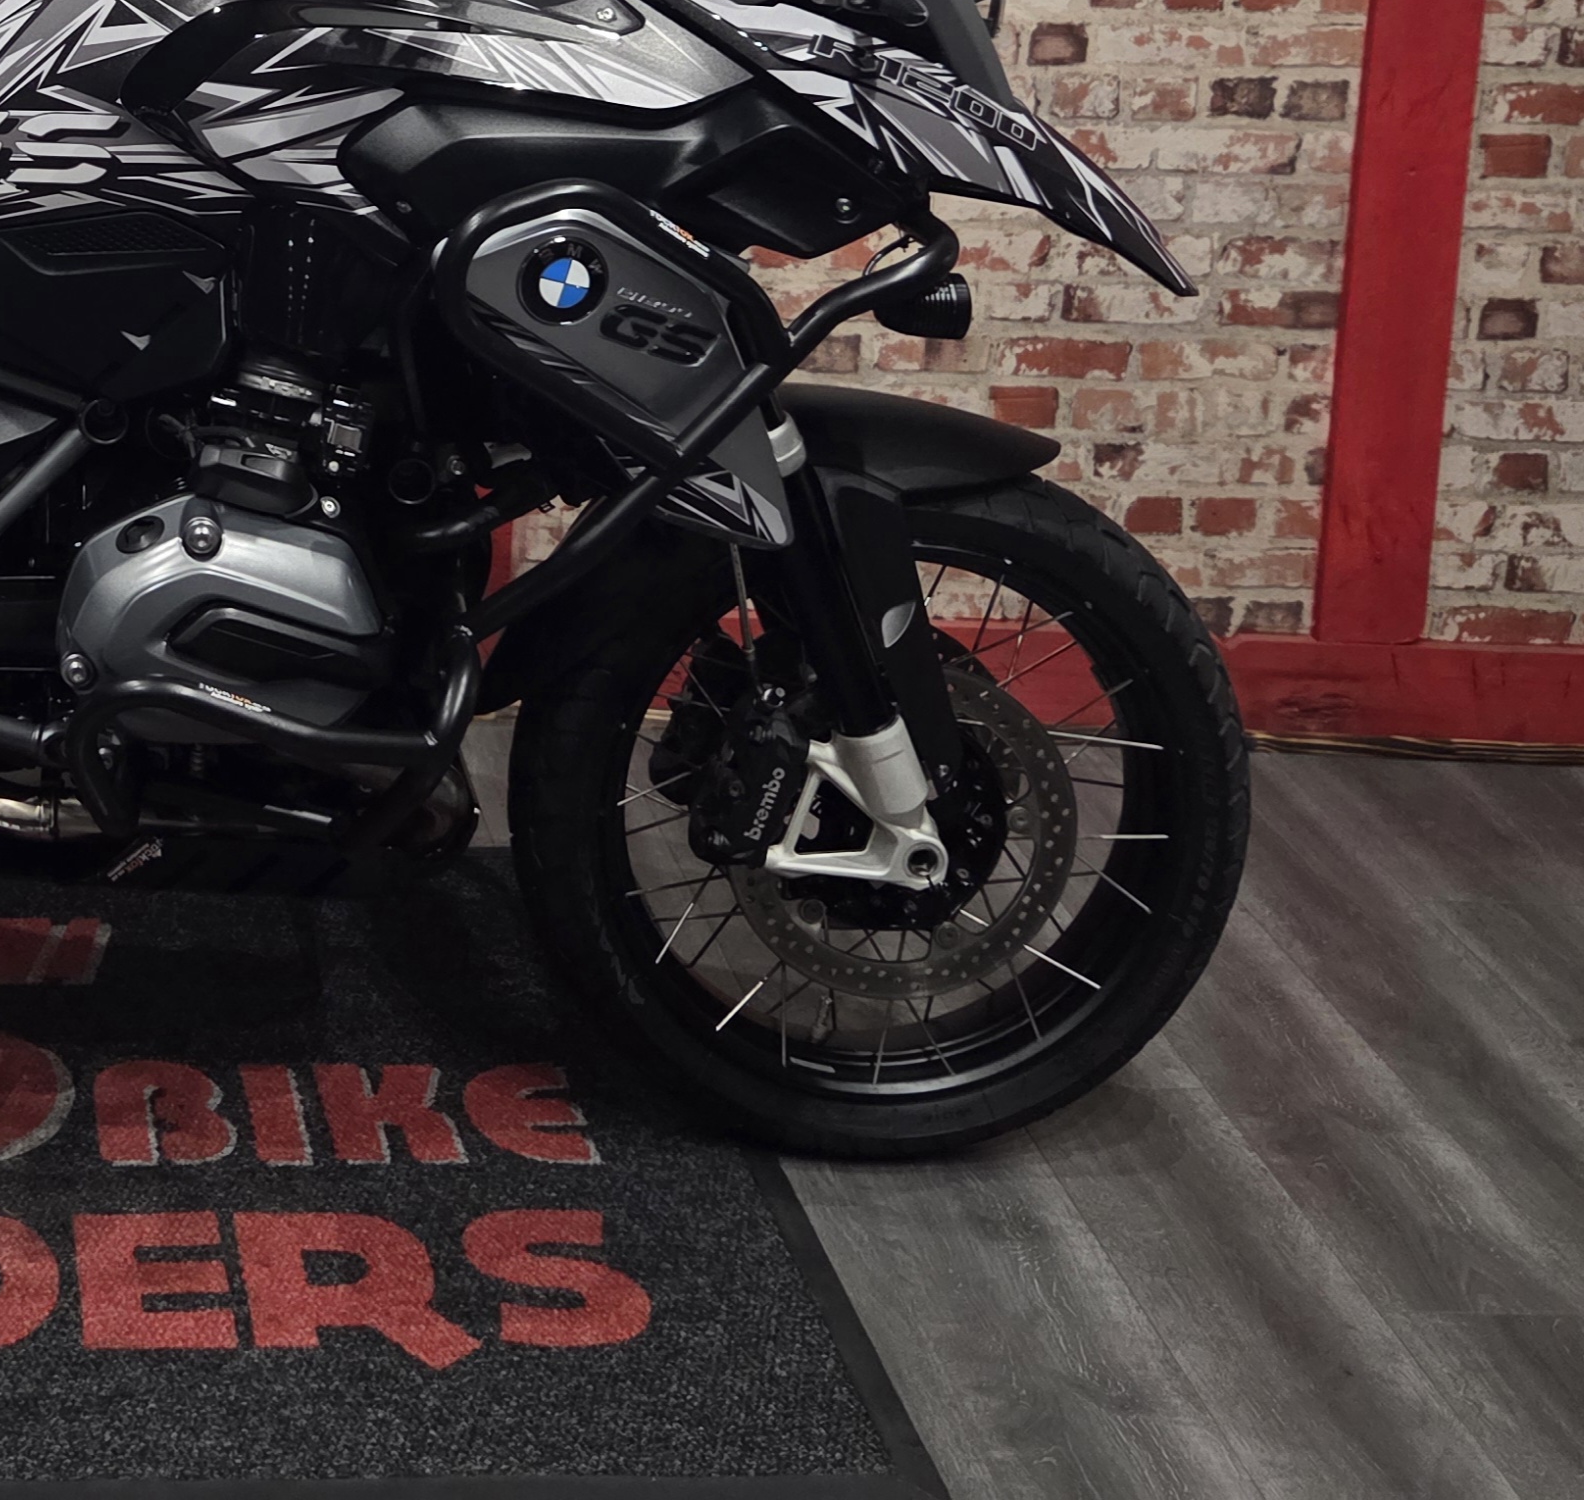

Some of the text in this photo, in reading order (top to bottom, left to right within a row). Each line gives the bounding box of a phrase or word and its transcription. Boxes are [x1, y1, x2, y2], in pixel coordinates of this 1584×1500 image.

[599, 303, 720, 367] GS
[743, 767, 786, 841] brembo
[93, 1059, 605, 1166] BIKE
